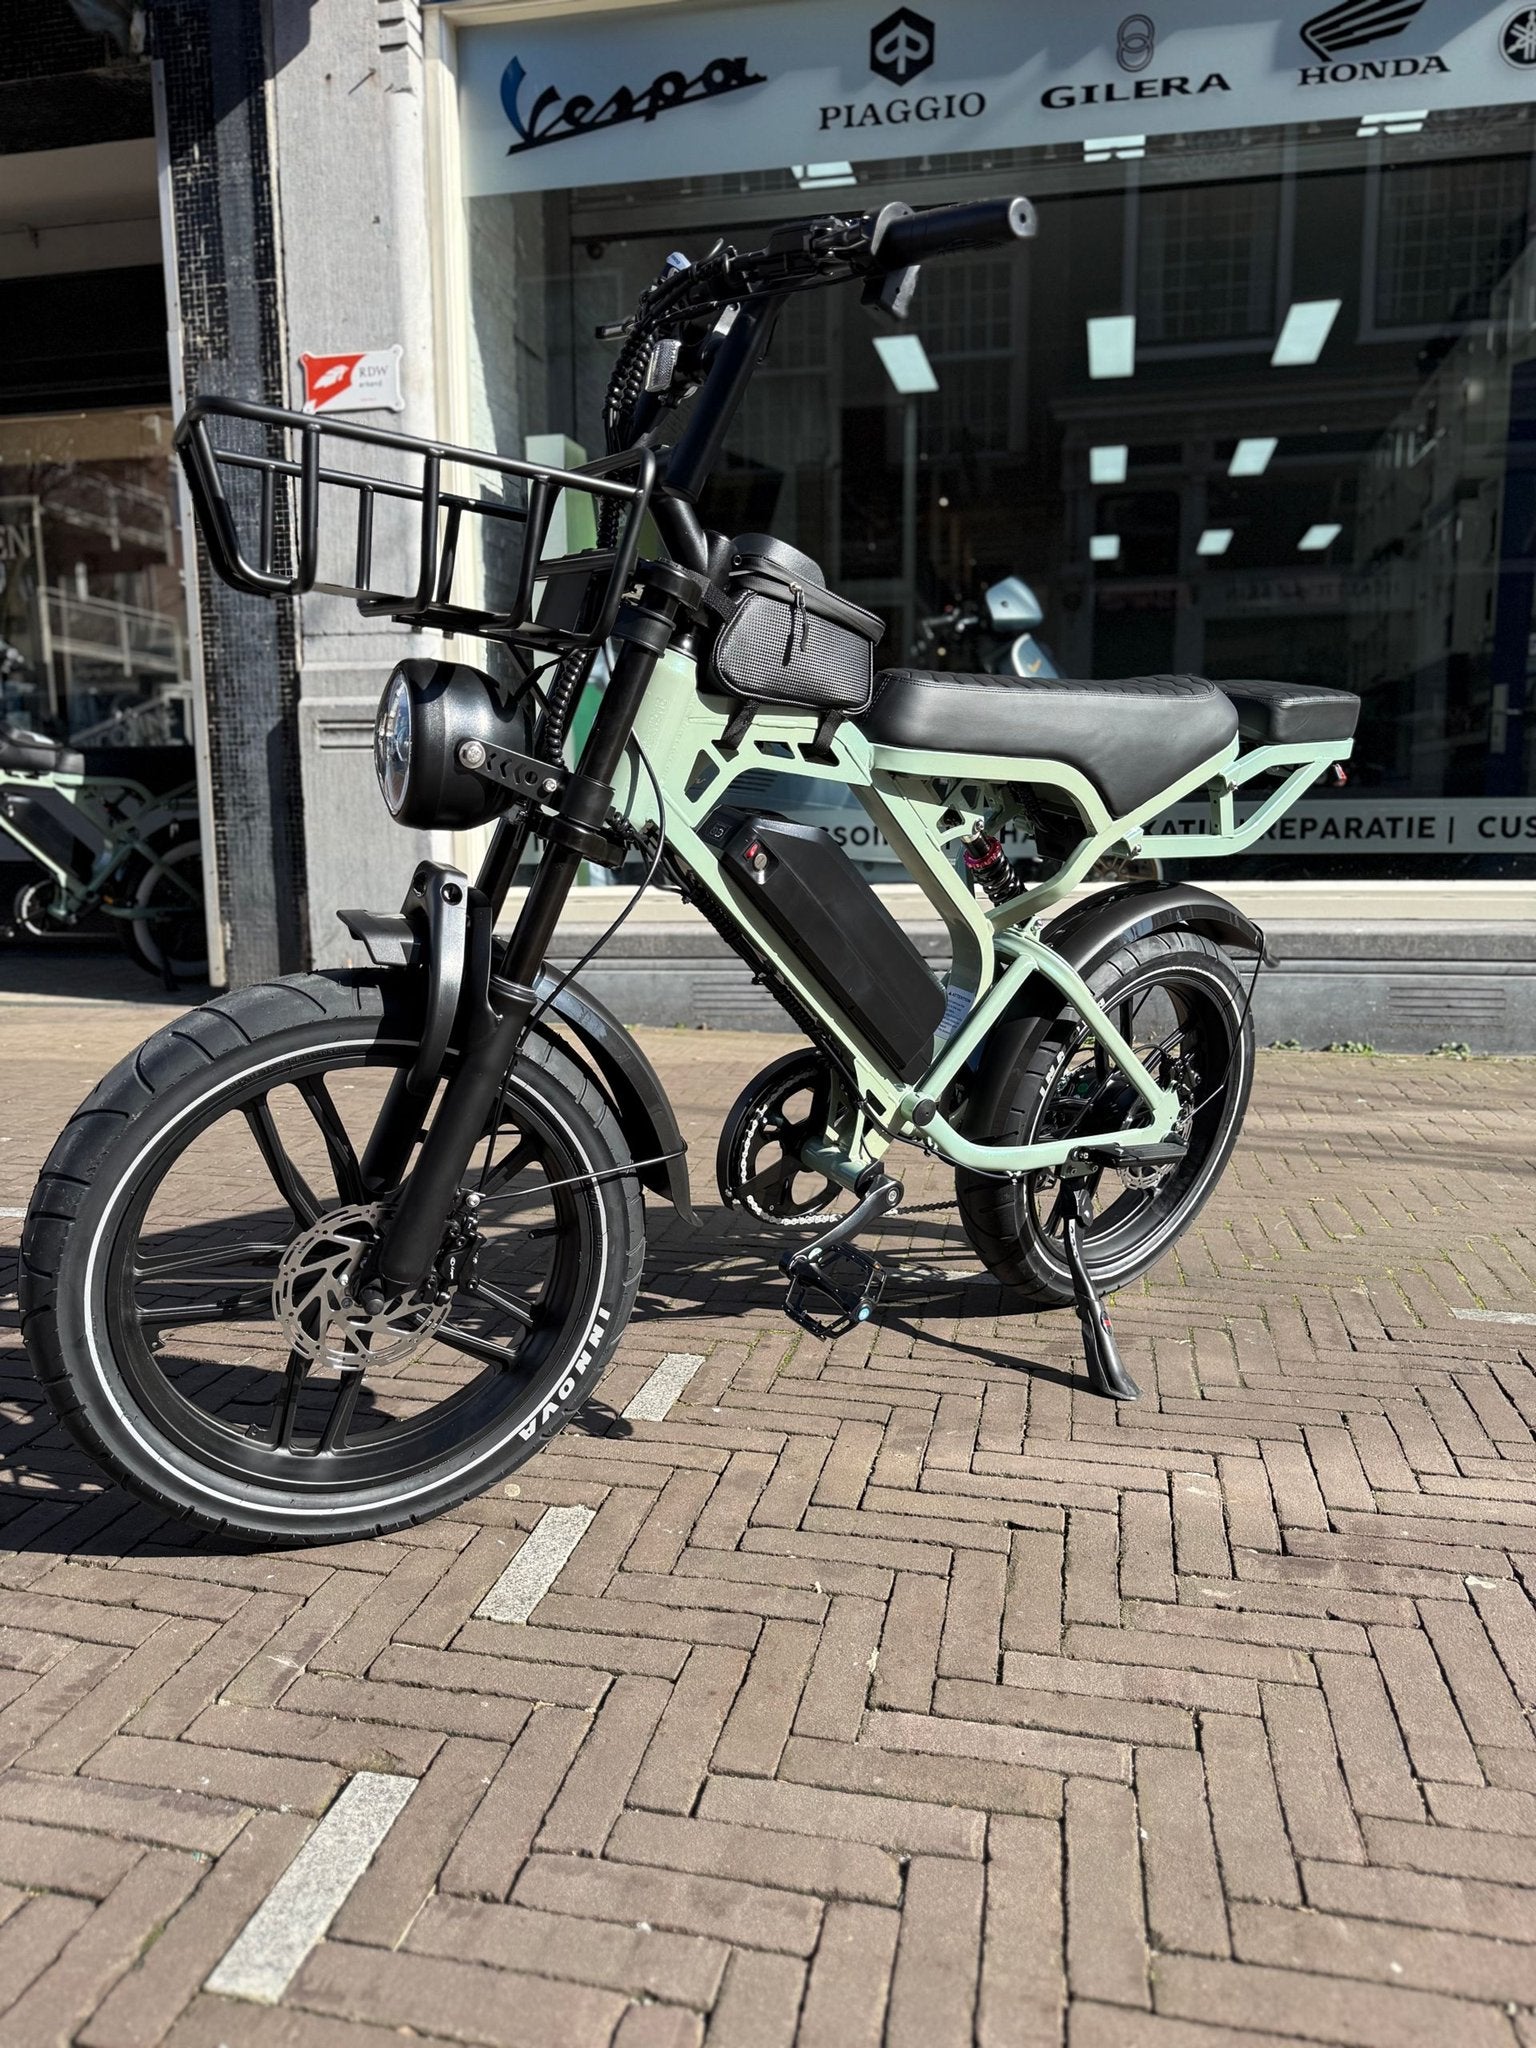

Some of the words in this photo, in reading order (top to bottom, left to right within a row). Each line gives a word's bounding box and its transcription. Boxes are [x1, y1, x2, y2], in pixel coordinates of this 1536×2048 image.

[1297, 55, 1450, 87] HONDA
[500, 55, 768, 157] Vespa
[1040, 73, 1231, 110] GILERA
[818, 91, 987, 131] PIAGGIO
[359, 365, 389, 378] RDW
[518, 1306, 611, 1441] INNOVA
